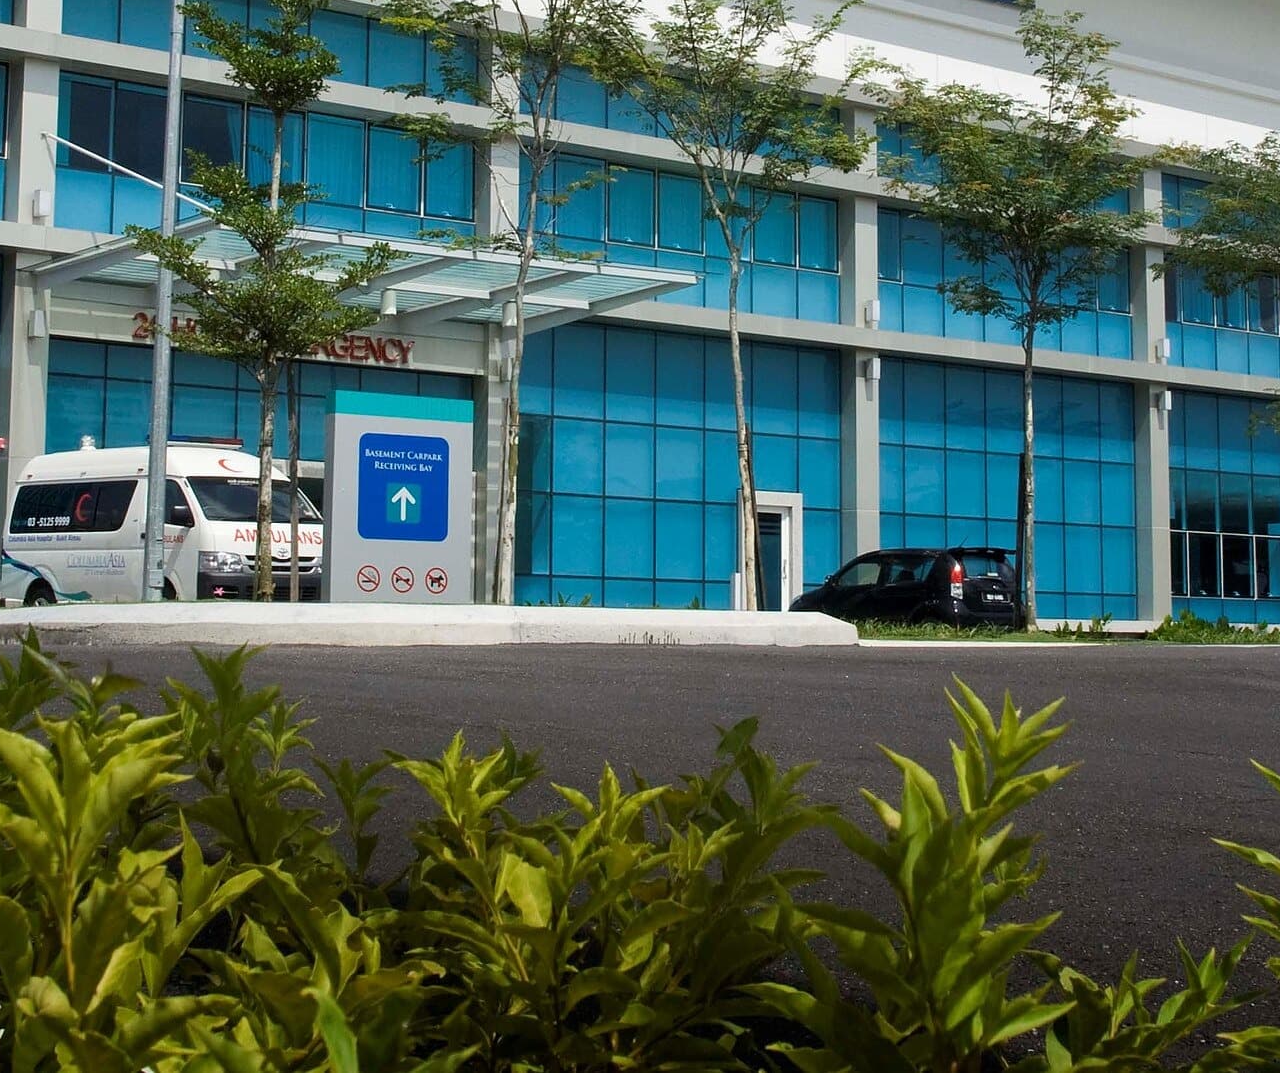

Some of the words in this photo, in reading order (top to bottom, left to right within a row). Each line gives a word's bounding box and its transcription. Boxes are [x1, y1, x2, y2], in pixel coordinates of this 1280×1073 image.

[365, 448, 405, 460] BASEMENT
[407, 450, 443, 462] CARPARK
[374, 460, 417, 471] RECEIVING
[419, 463, 433, 472] BAY
[27, 517, 36, 527] 03
[234, 528, 323, 545] AMULANS
